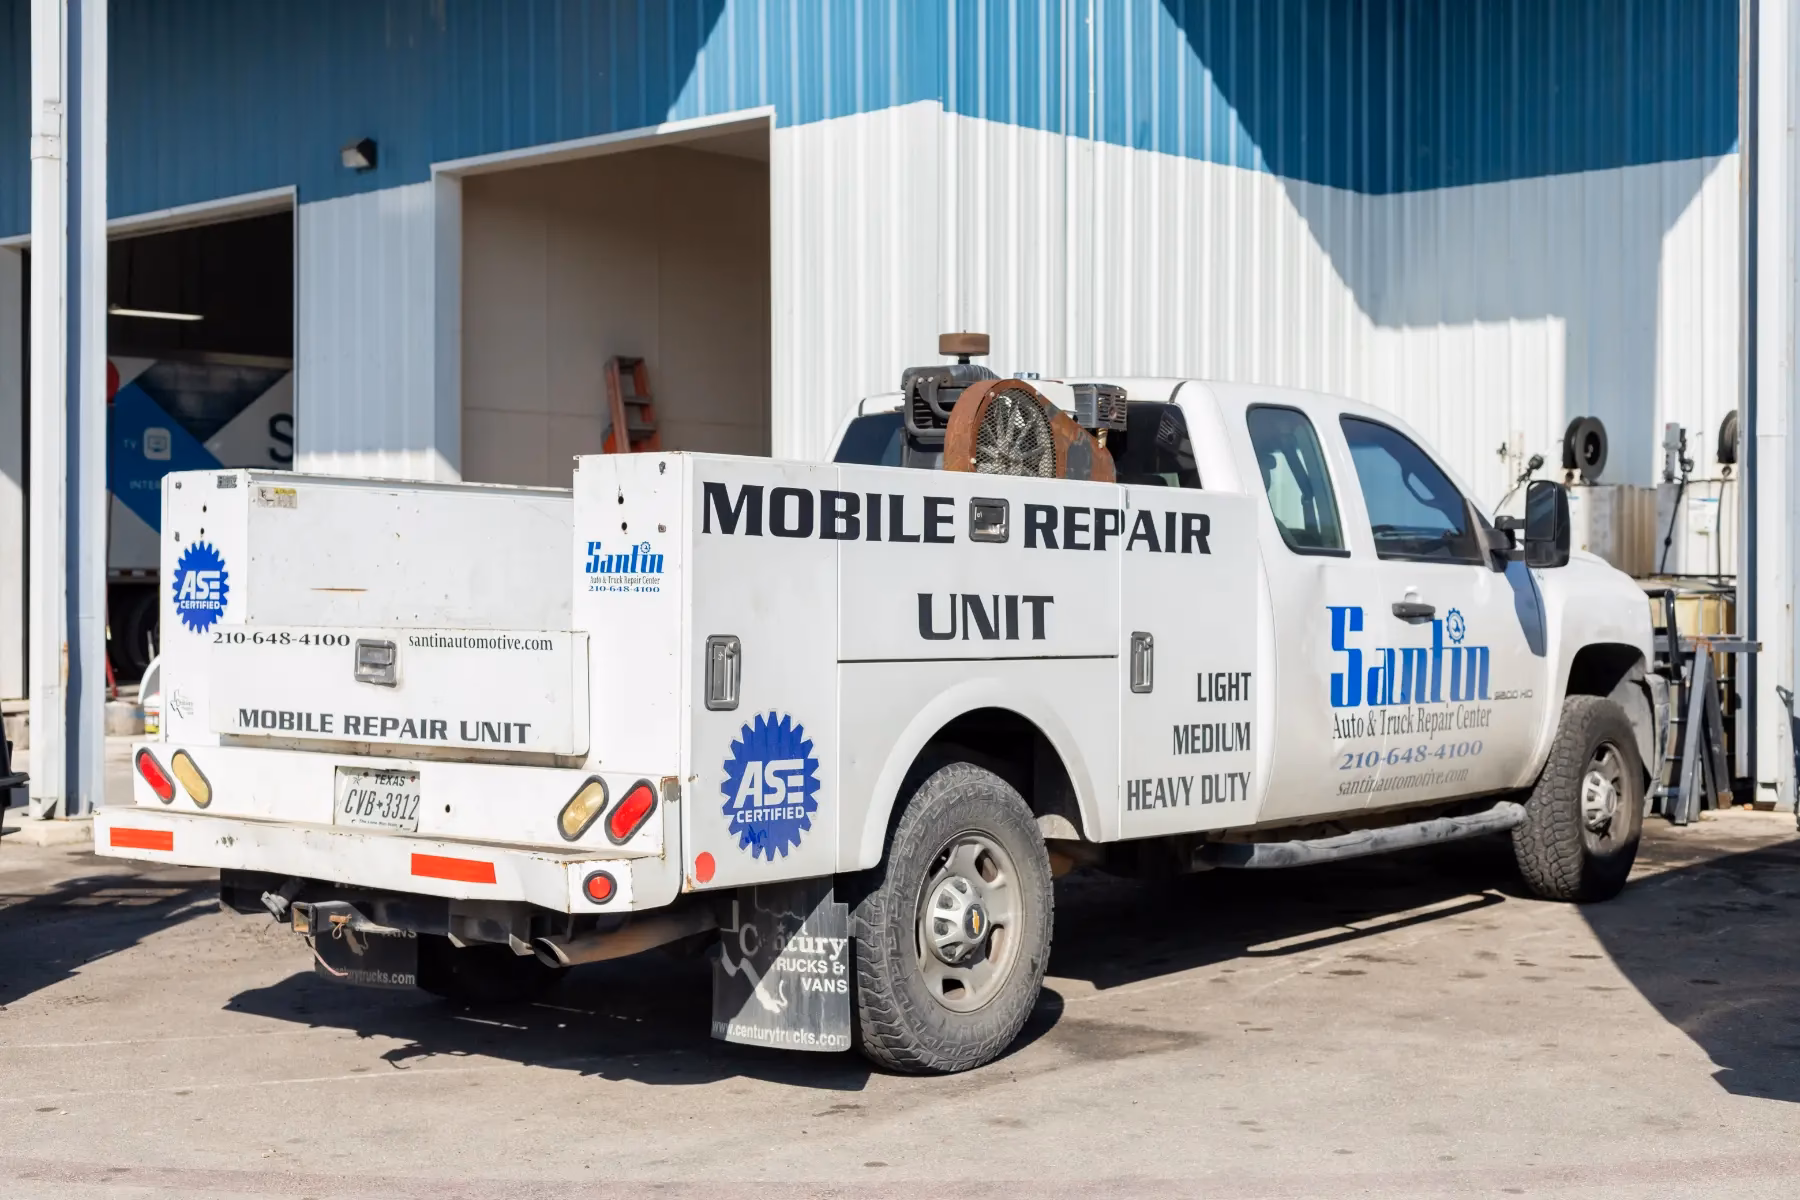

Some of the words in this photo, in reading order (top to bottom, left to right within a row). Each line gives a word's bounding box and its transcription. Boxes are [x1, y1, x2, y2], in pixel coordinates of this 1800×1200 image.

[702, 481, 955, 543] MOBILE
[1023, 503, 1212, 554] REPAIR
[585, 541, 664, 573] Santin
[179, 570, 221, 600] ASE
[180, 600, 221, 610] CERTIFIED
[917, 593, 1055, 641] UNIT
[213, 632, 350, 647] 210-648-4100
[409, 633, 553, 651] santinautomotive.com
[1326, 606, 1492, 708] Santin
[1197, 672, 1251, 702] LIGHT
[239, 708, 333, 733] MOBILE
[343, 714, 448, 740] REPAIR
[460, 720, 531, 744] UNIT
[1332, 712, 1364, 740] Auto
[1367, 710, 1377, 737] &
[1380, 706, 1414, 736] Truck
[1417, 702, 1454, 740] Repair
[1456, 706, 1492, 729] Center
[1173, 722, 1251, 755] MEDIUM
[1339, 740, 1483, 770] 210-648-4100
[374, 773, 406, 787] TEXAS
[732, 759, 804, 808] ASE
[1127, 776, 1194, 811] HEAVY
[1201, 772, 1251, 804] DUTY
[1336, 767, 1469, 796] santinautomotive.com
[736, 806, 805, 823] CERTIFIED
[739, 923, 848, 961] Cntury
[771, 957, 828, 974] RUCKS
[801, 977, 848, 994] VANS
